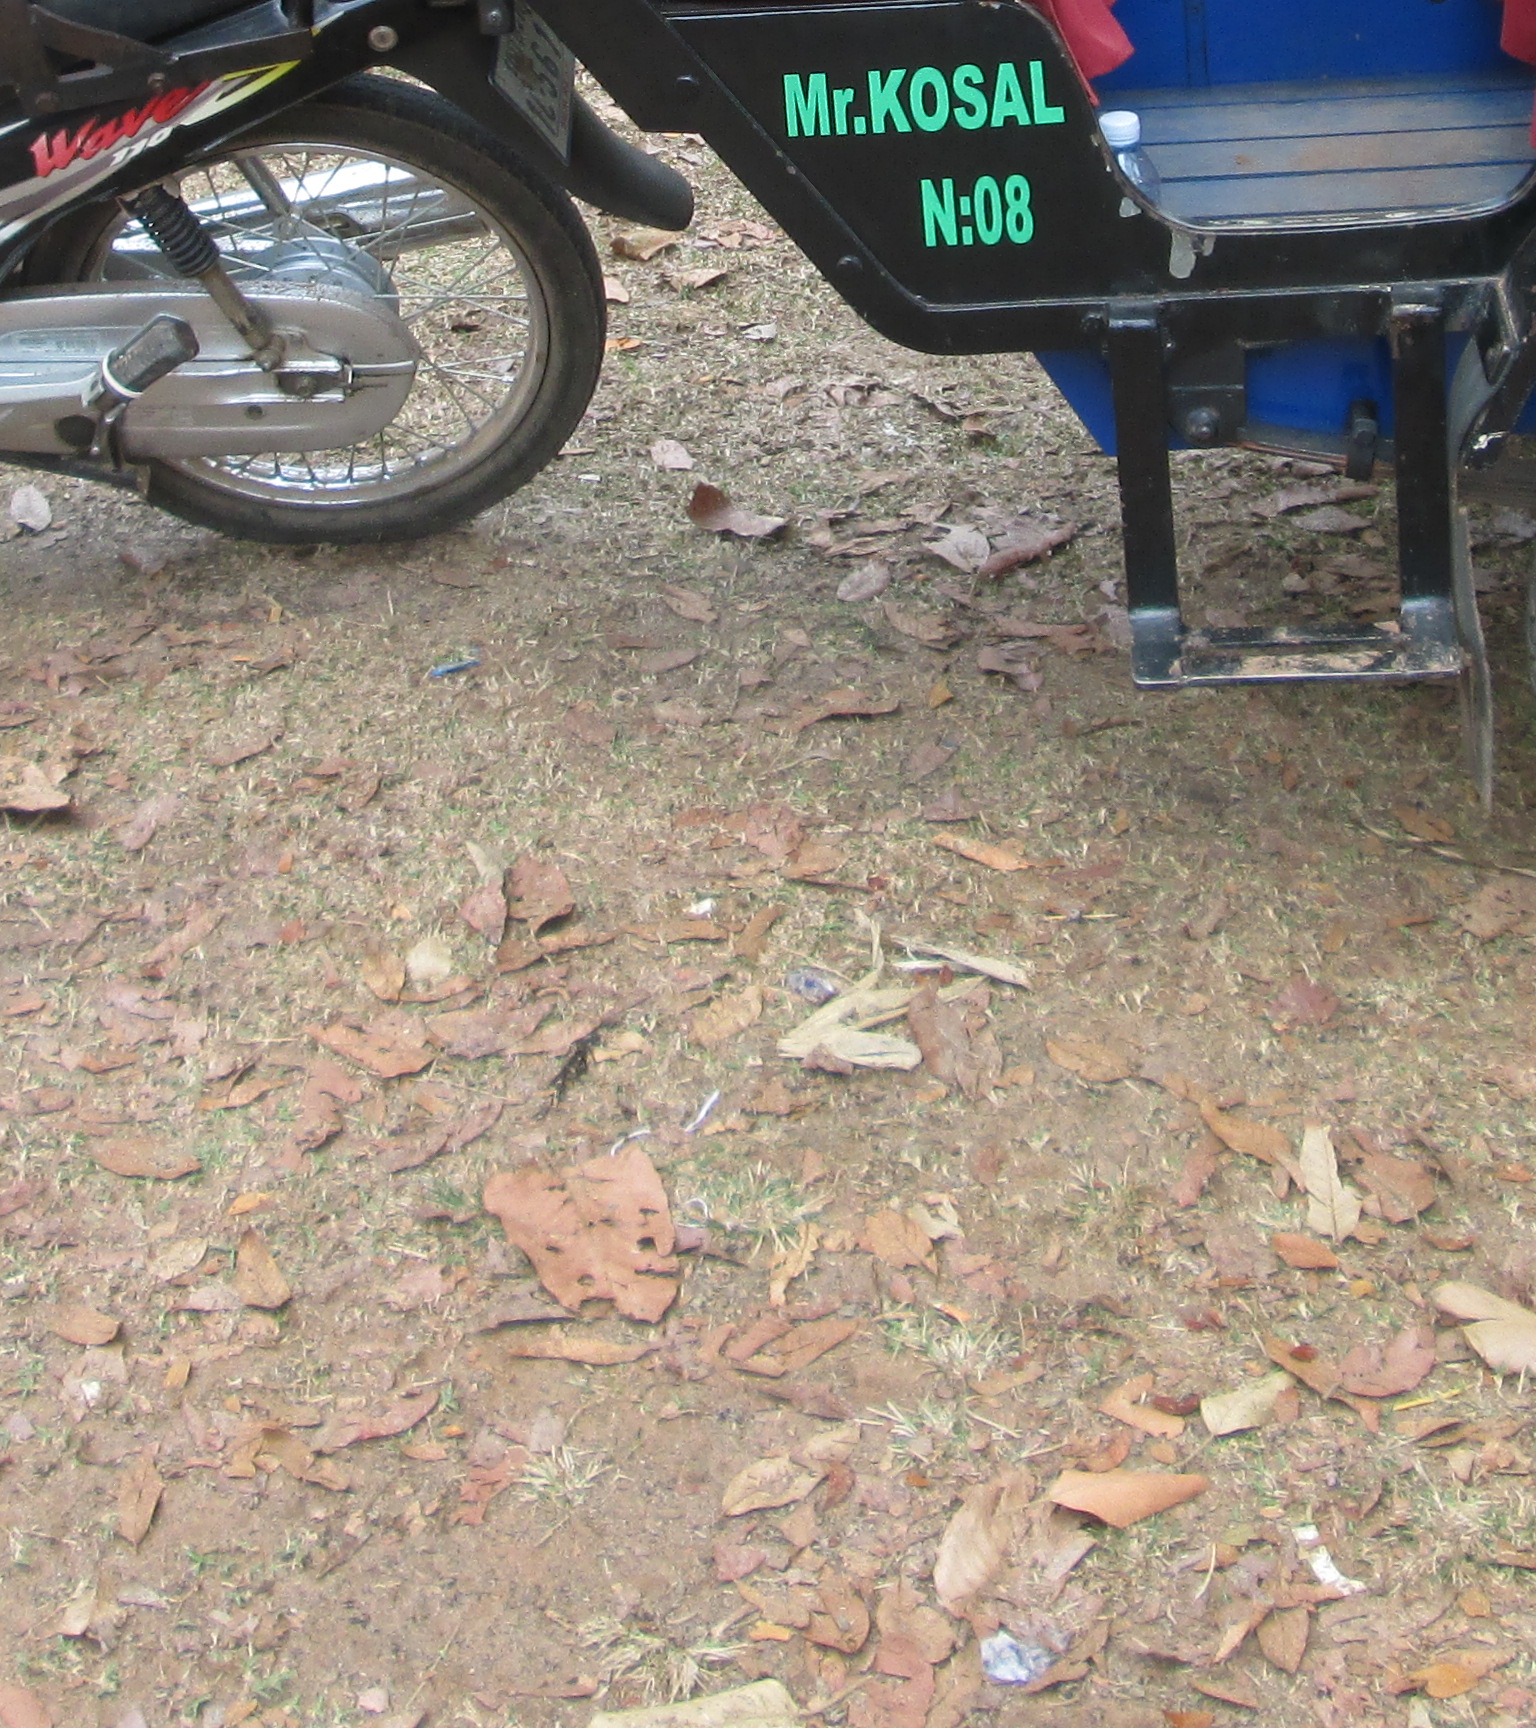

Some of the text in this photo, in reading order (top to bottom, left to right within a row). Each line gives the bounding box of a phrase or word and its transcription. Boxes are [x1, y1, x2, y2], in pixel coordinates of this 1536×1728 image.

[28, 79, 213, 178] Wave
[783, 60, 1065, 137] Mr.KOSAL
[920, 174, 1034, 247] N:08
